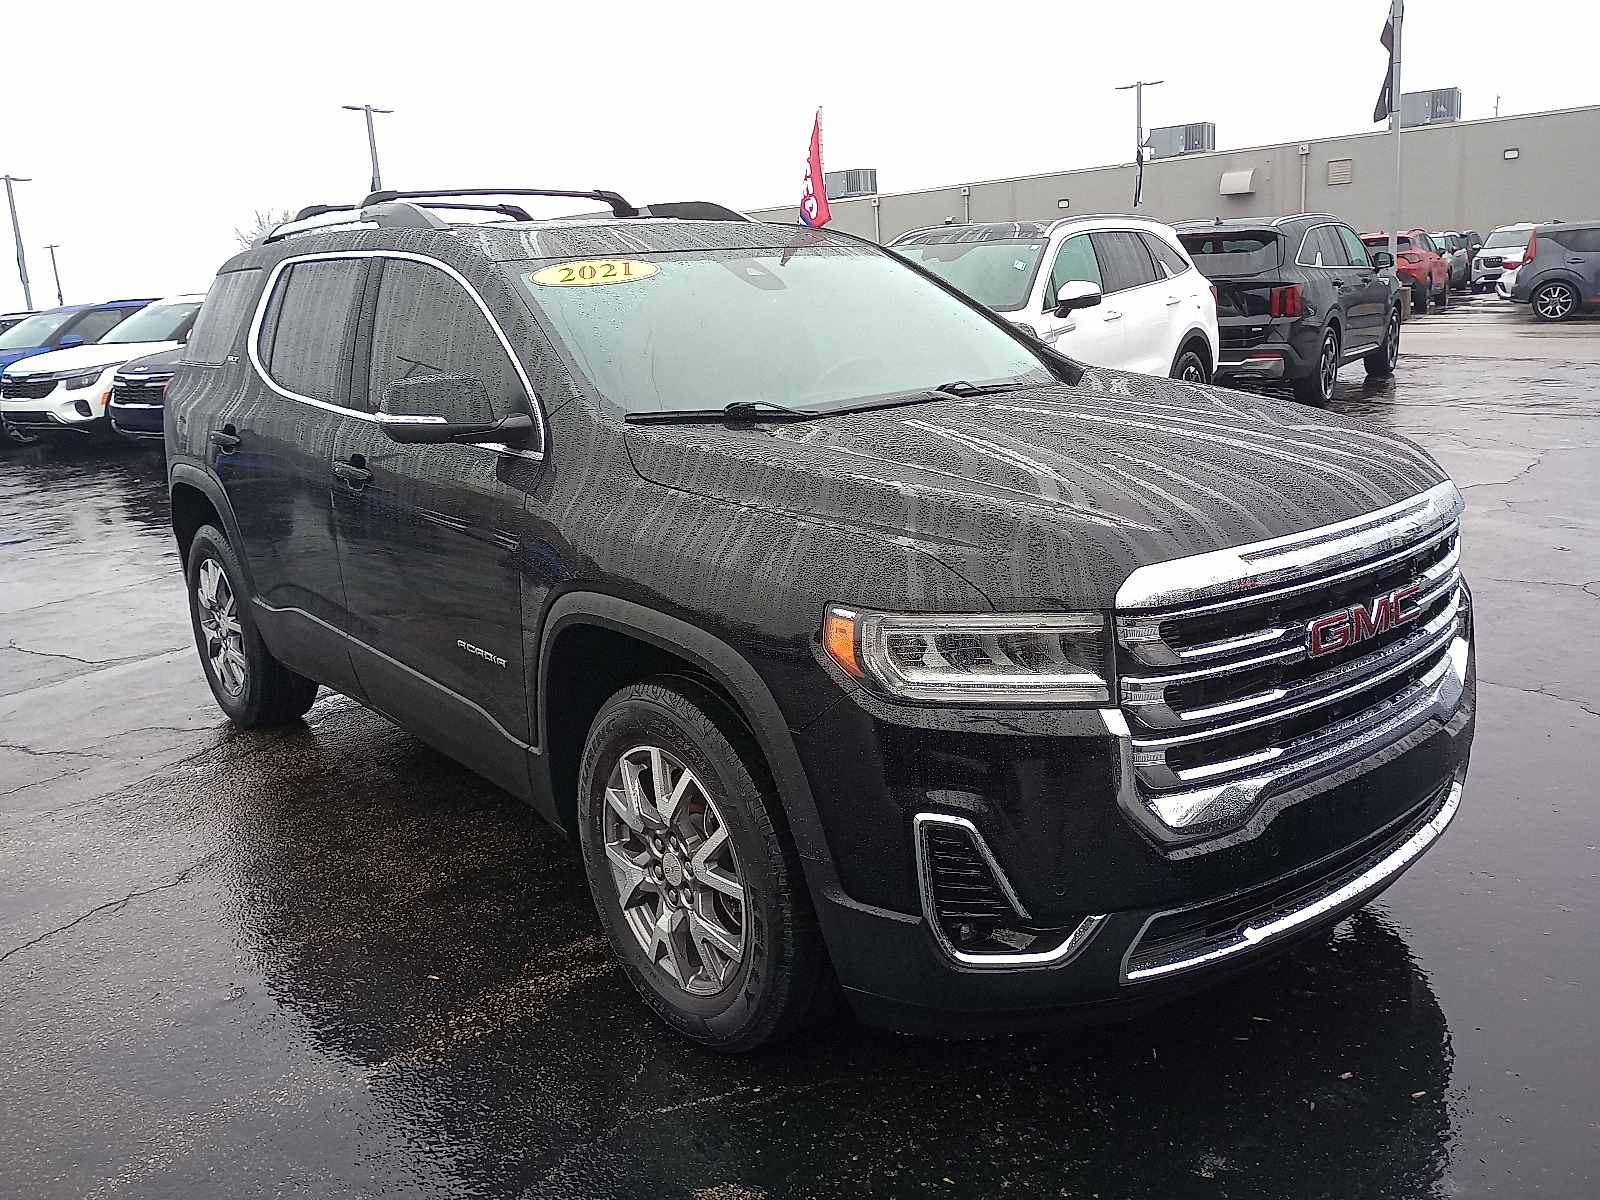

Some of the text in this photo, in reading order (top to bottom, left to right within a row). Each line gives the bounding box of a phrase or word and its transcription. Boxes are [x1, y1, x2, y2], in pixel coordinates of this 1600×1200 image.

[558, 261, 634, 283] 2021
[1307, 585, 1422, 657] GMC
[457, 639, 508, 669] ACADIA
